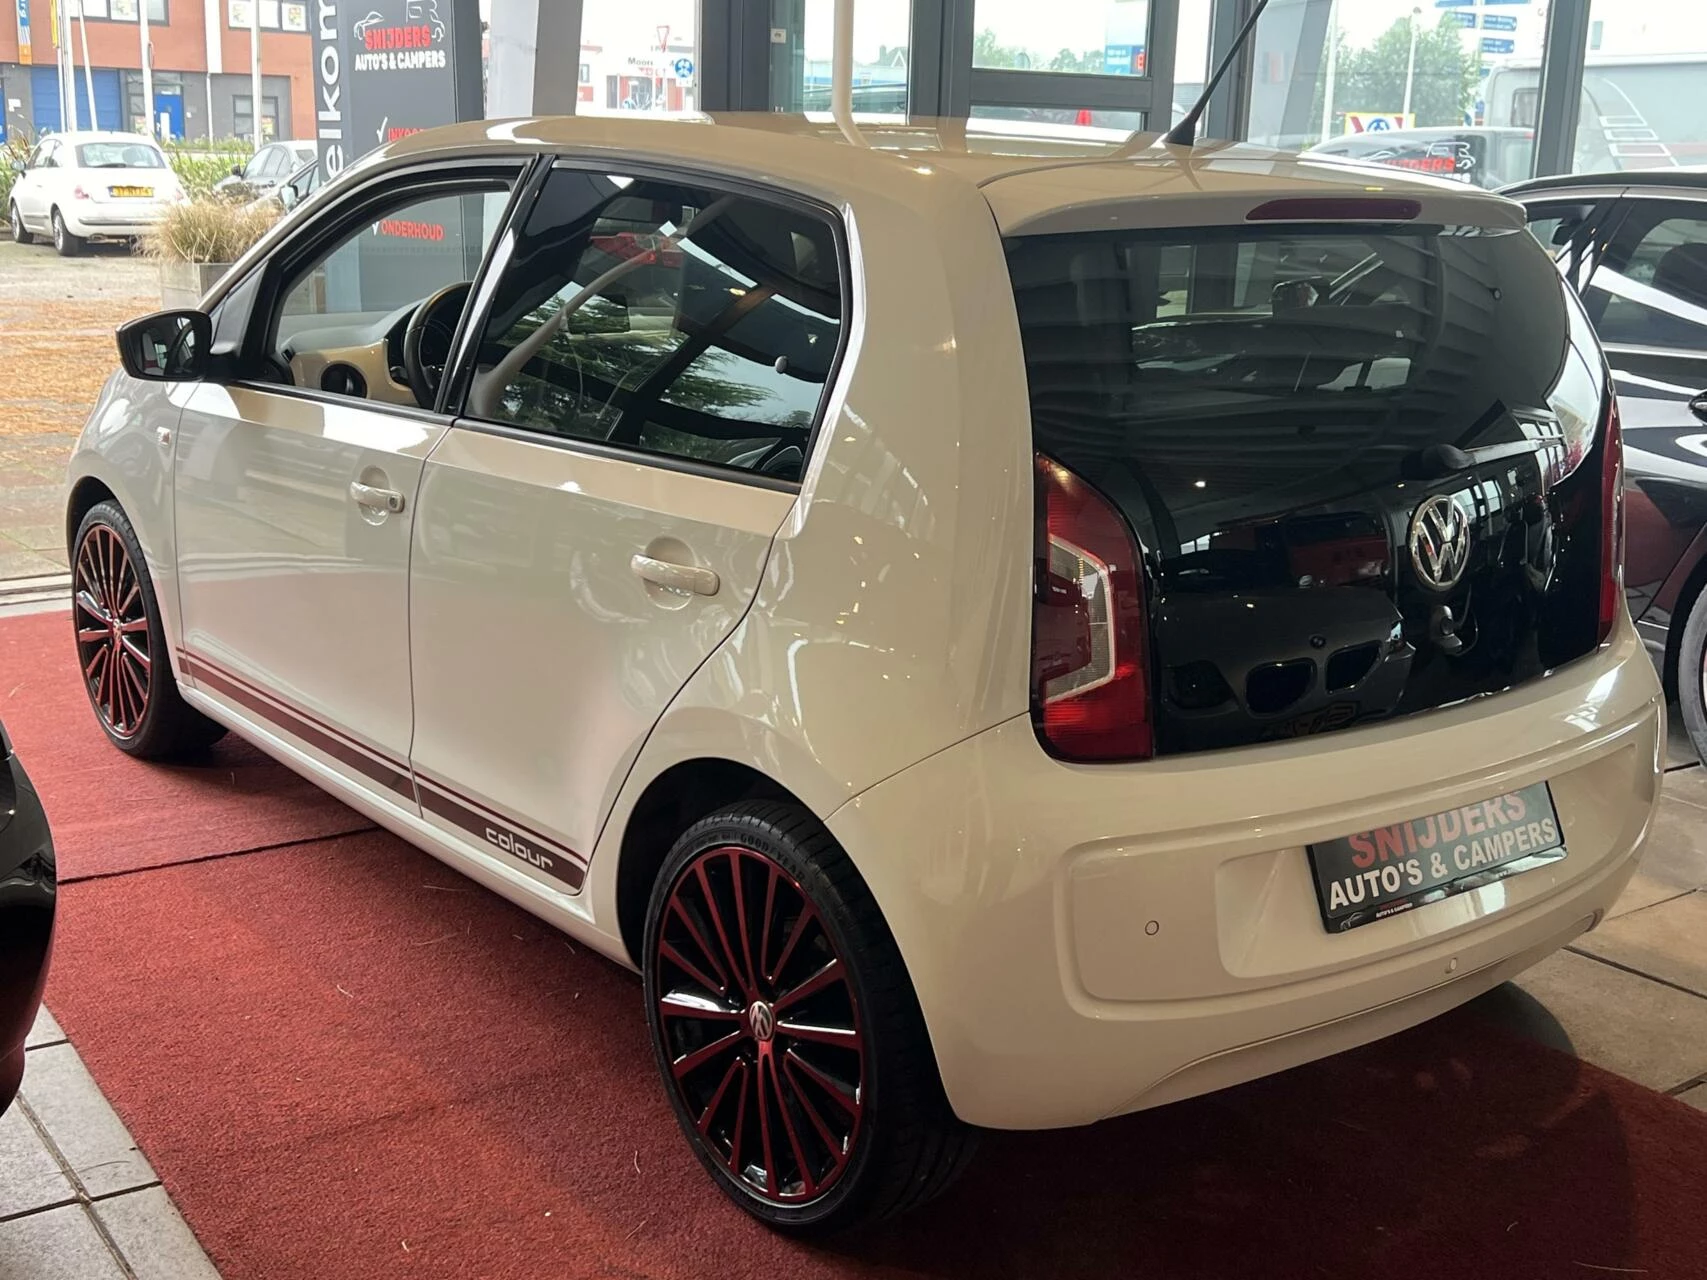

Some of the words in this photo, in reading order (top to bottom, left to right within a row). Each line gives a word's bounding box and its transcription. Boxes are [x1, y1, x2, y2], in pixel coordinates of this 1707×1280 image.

[355, 53, 388, 71] AUTO'S
[389, 52, 397, 69] &
[397, 50, 446, 69] CAMPERS
[365, 25, 431, 50] SNIJDERS
[317, 0, 345, 186] elkom
[381, 220, 445, 241] ONDERHOUD
[485, 827, 554, 869] colour
[1348, 791, 1527, 869] SNIJDERS
[740, 832, 806, 885] GOODYEAR
[1329, 858, 1424, 911] AUTO'S
[1430, 851, 1448, 879] &
[1453, 817, 1557, 871] CAMPERS
